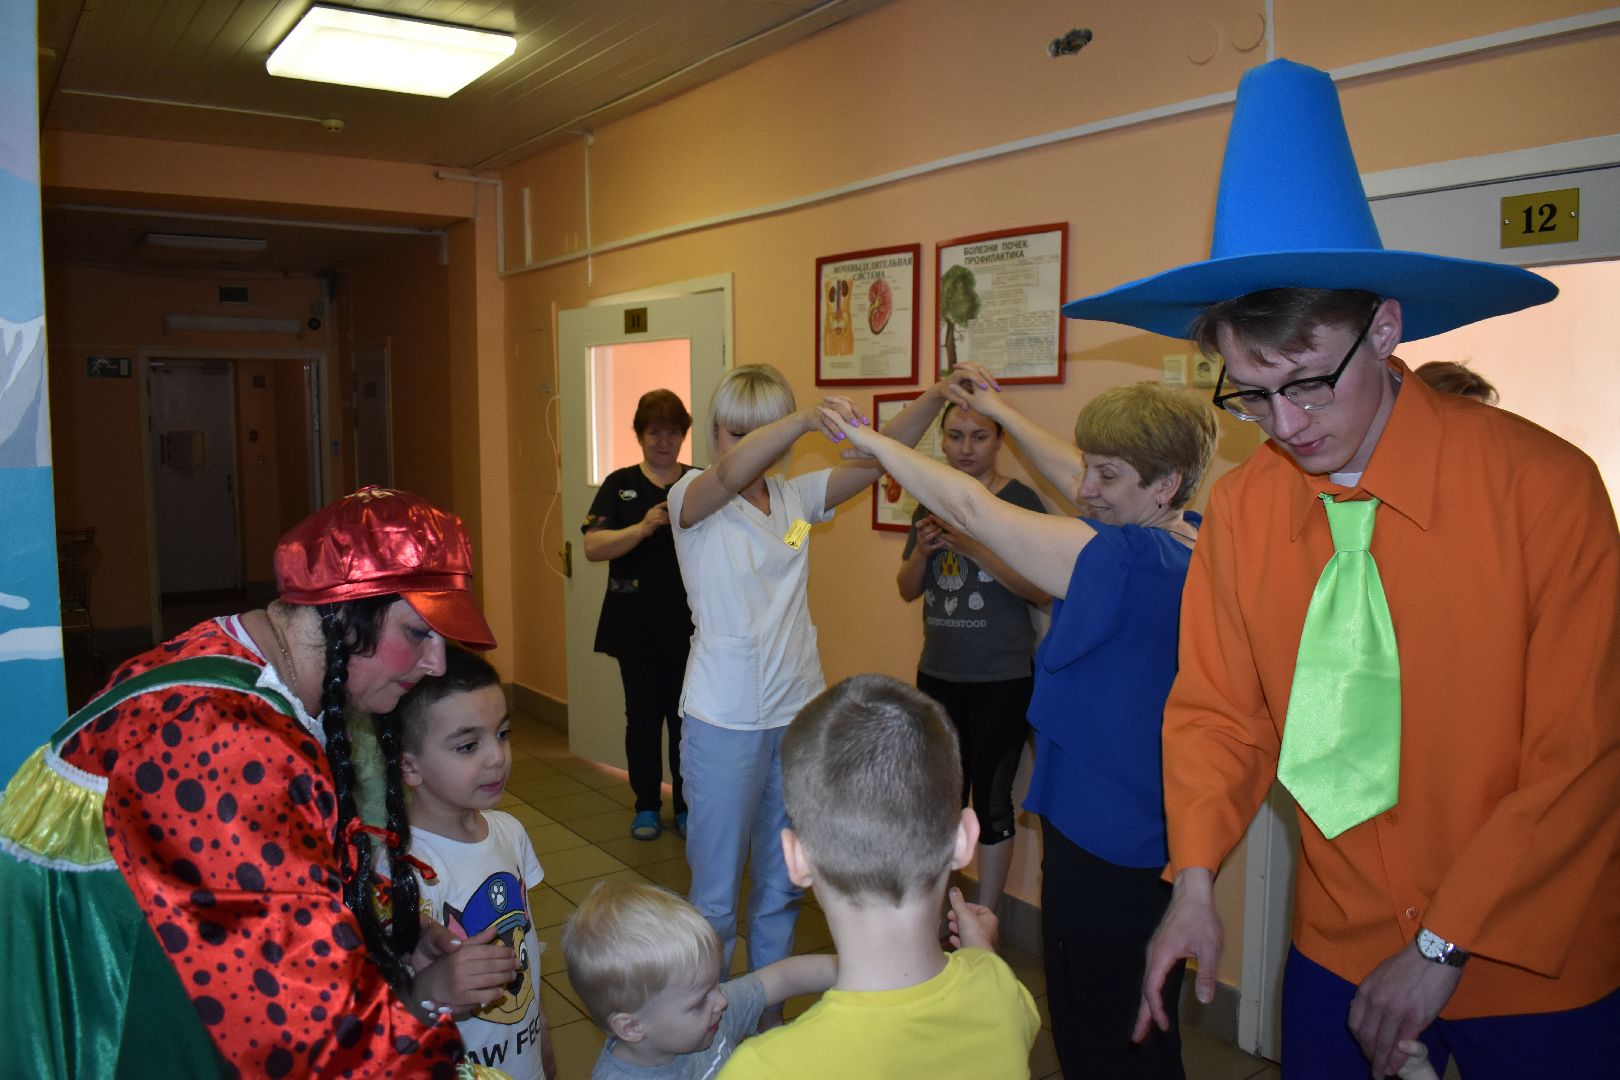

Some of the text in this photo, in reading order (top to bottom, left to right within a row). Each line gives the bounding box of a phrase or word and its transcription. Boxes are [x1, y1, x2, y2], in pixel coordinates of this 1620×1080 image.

[1522, 203, 1557, 234] 12
[964, 244, 998, 256] БОЛЕЗНИ
[965, 250, 1024, 265] ПРОФИЛАКТИКА
[833, 257, 913, 274] МОЧЕВЫДЕЛИТЕЛЬНАЯ
[853, 270, 885, 281] СИСТЕМА
